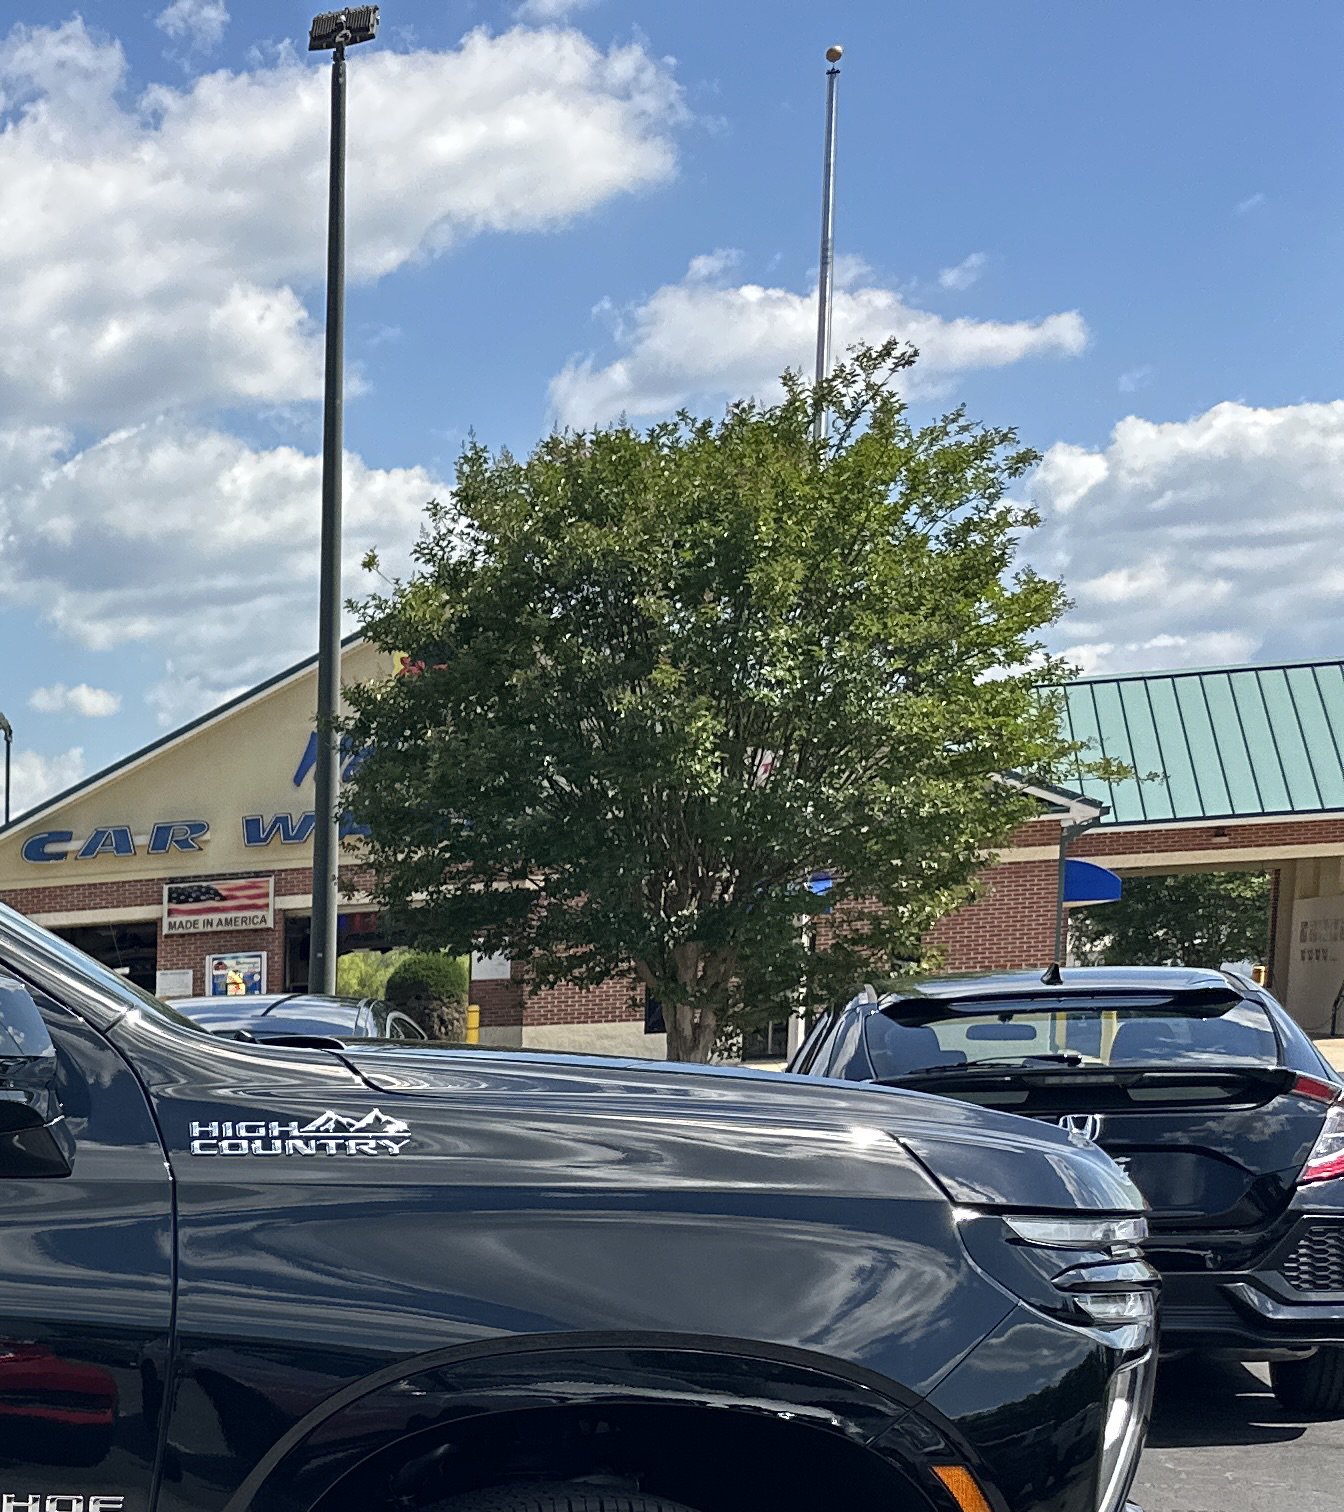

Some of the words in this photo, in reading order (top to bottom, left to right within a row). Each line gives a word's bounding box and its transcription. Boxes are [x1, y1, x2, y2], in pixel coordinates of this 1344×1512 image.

[21, 820, 210, 864] CAR
[168, 919, 200, 931] MADE
[203, 918, 213, 929] IN
[215, 914, 268, 928] AMERICA
[189, 1121, 301, 1138] HIGH
[190, 1139, 411, 1156] COUNTRY
